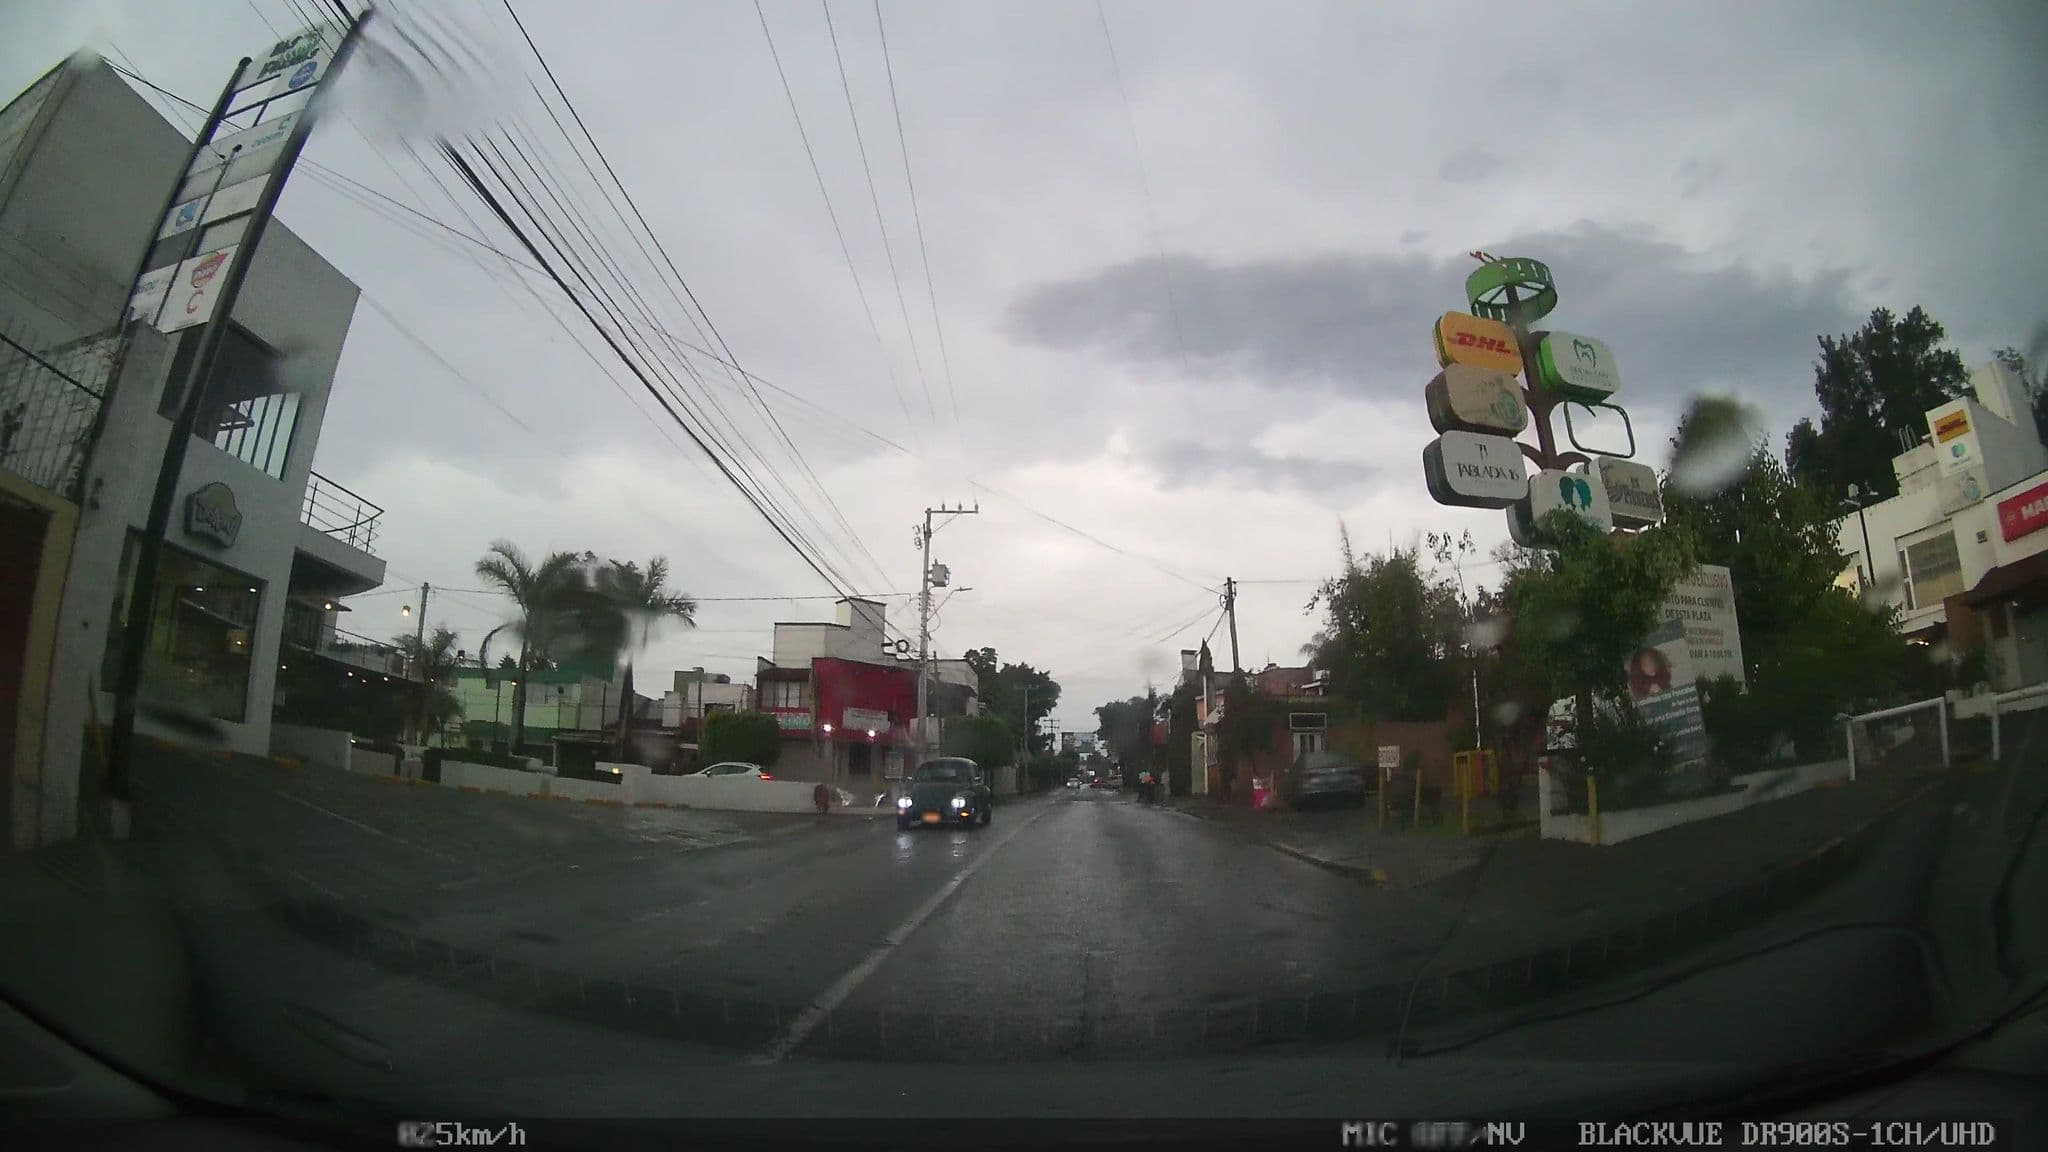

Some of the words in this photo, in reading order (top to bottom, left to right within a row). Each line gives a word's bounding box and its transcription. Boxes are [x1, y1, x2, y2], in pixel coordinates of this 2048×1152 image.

[1456, 332, 1510, 353] DHL
[1457, 463, 1507, 480] TABLADA
[1665, 608, 1675, 619] DE
[1675, 609, 1690, 620] ESTA
[1692, 610, 1712, 621] PLAZA
